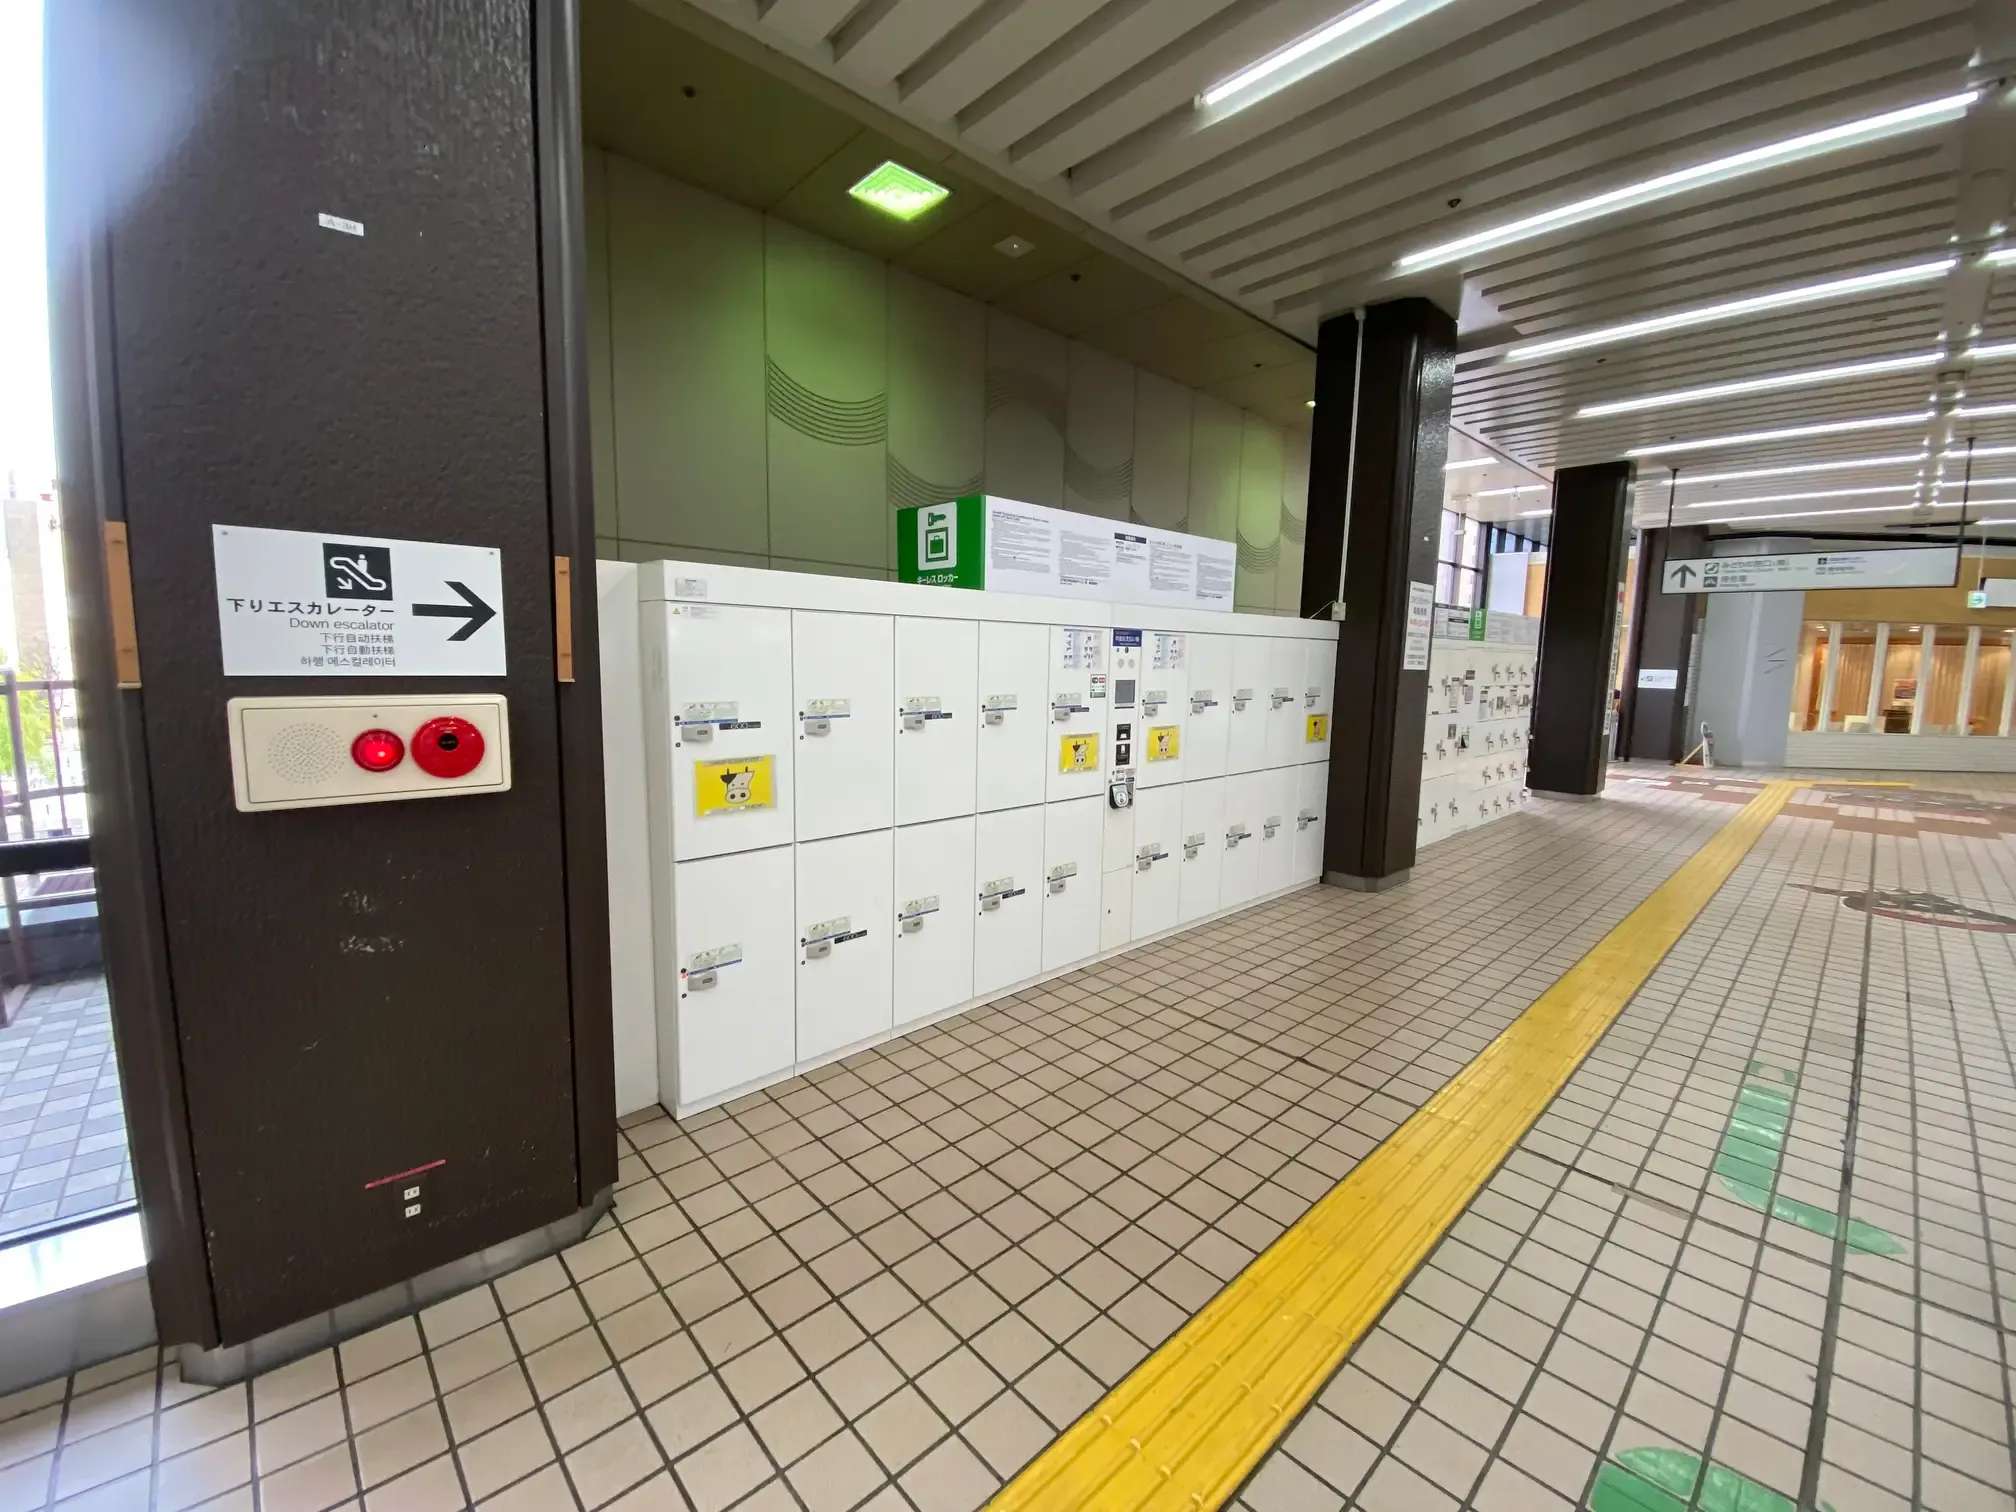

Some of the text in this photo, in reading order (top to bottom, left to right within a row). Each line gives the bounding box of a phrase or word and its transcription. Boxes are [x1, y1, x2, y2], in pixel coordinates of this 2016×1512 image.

[226, 597, 395, 617] 下りエスカレーター
[289, 617, 395, 631] Down escalator
[320, 632, 394, 644] 下行自动扶梯
[321, 644, 395, 656] 下行自動扶梯
[300, 656, 324, 667] 하행
